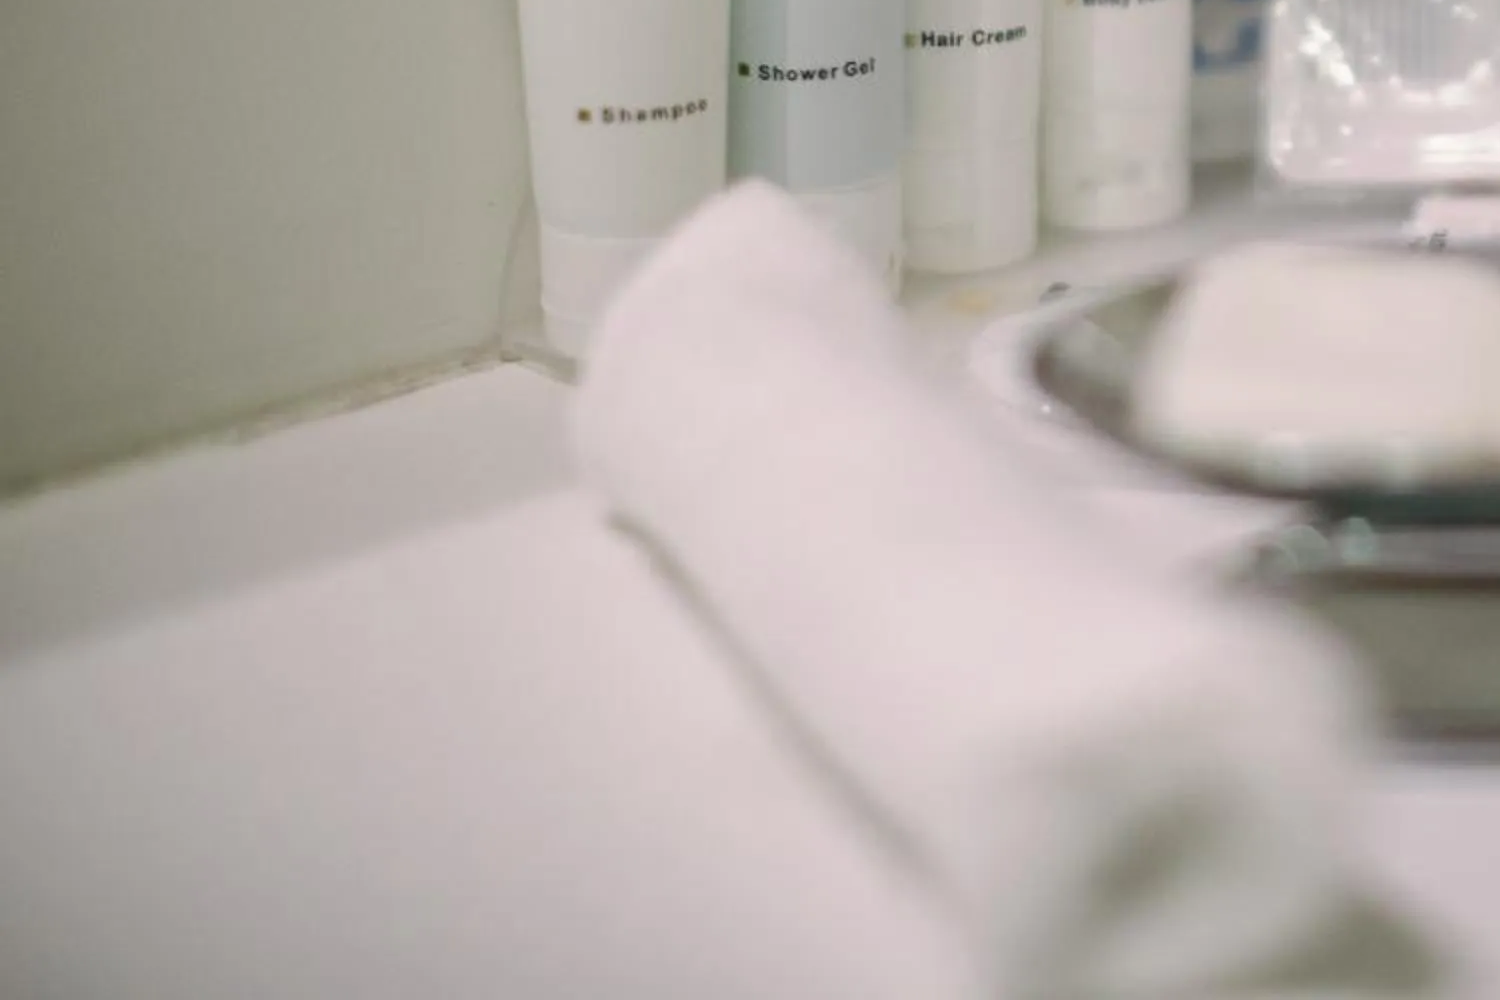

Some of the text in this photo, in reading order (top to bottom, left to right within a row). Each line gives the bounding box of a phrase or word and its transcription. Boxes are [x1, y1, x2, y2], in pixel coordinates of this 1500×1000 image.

[921, 25, 1027, 48] Hair Cream
[758, 56, 876, 82] Shower Gel
[602, 97, 708, 125] Shampoo
